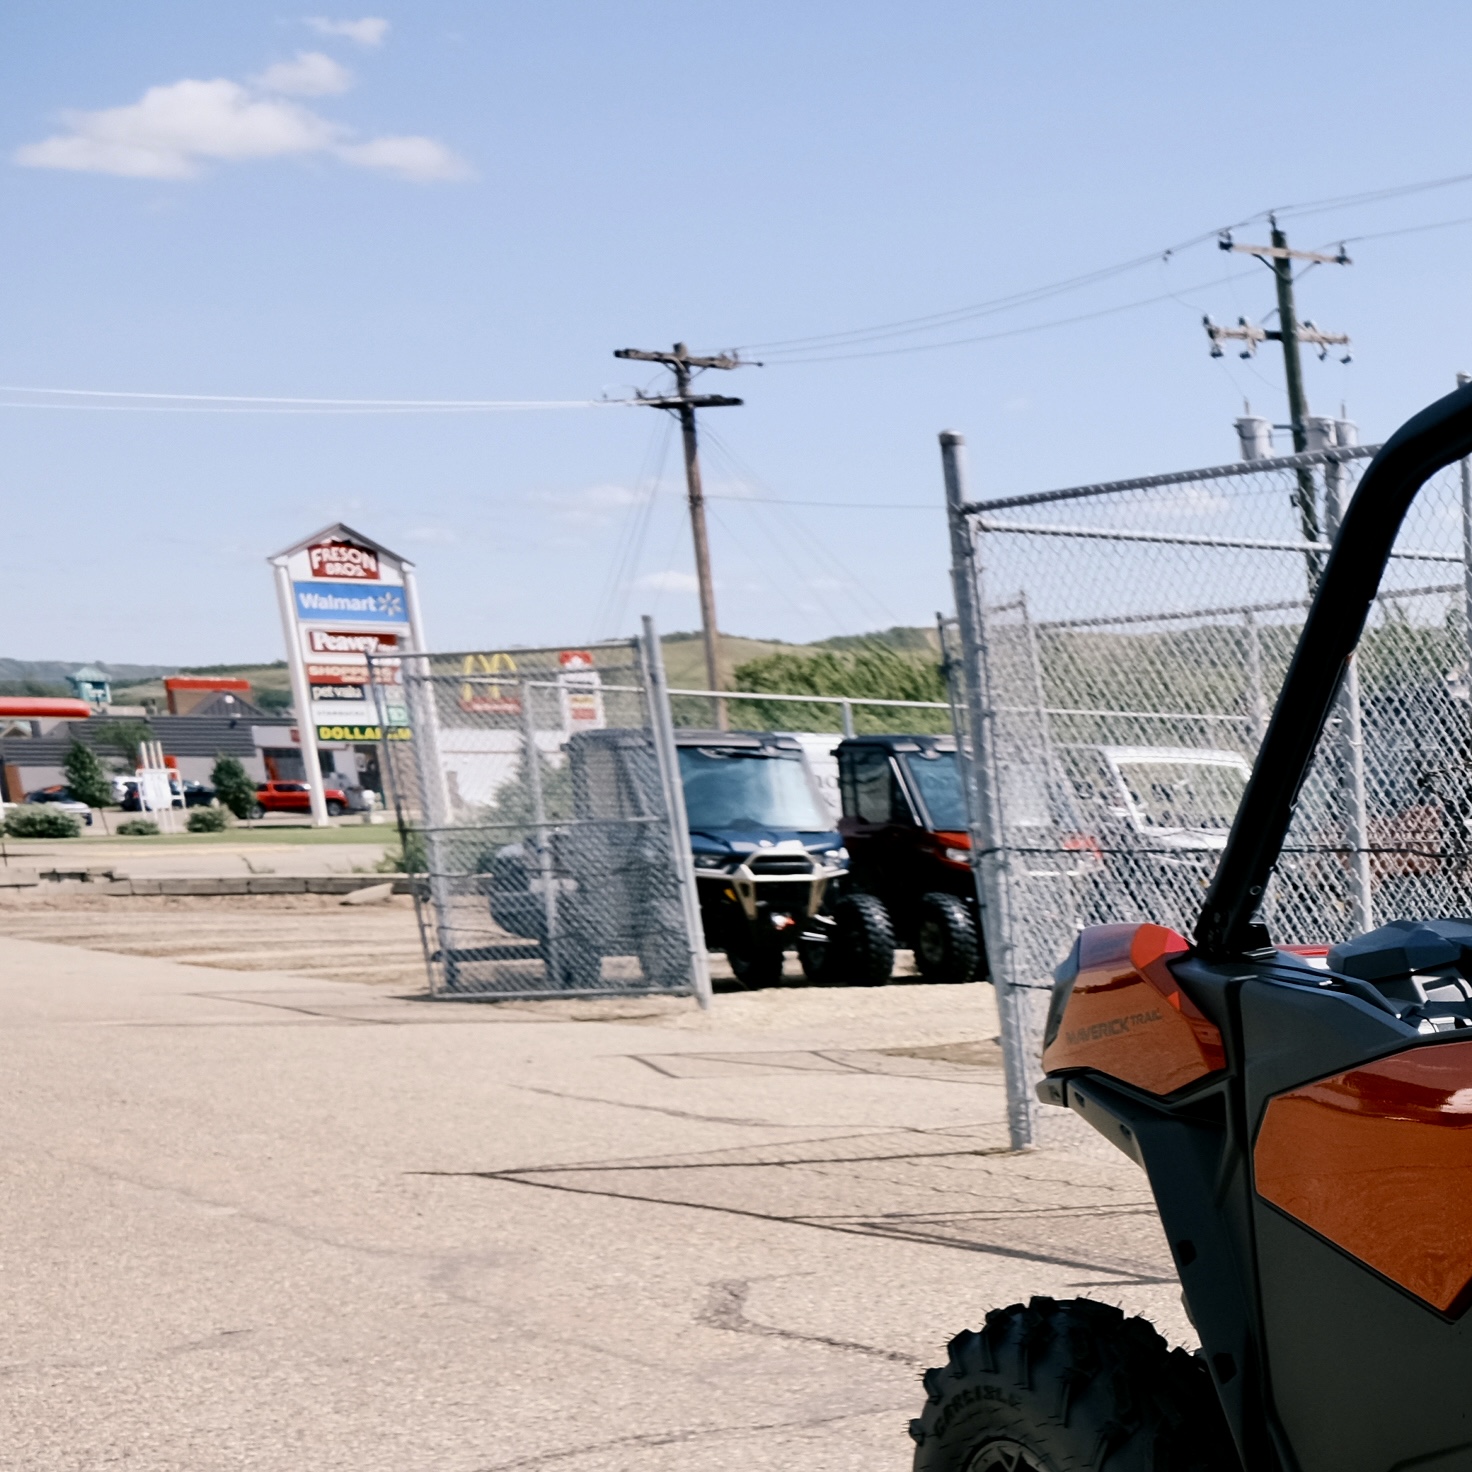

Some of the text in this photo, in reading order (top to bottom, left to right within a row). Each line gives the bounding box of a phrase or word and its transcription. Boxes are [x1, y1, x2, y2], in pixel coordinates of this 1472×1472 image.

[310, 546, 378, 573] FRESON
[298, 592, 378, 612] Walmart
[1065, 1016, 1130, 1045] MAVERICK
